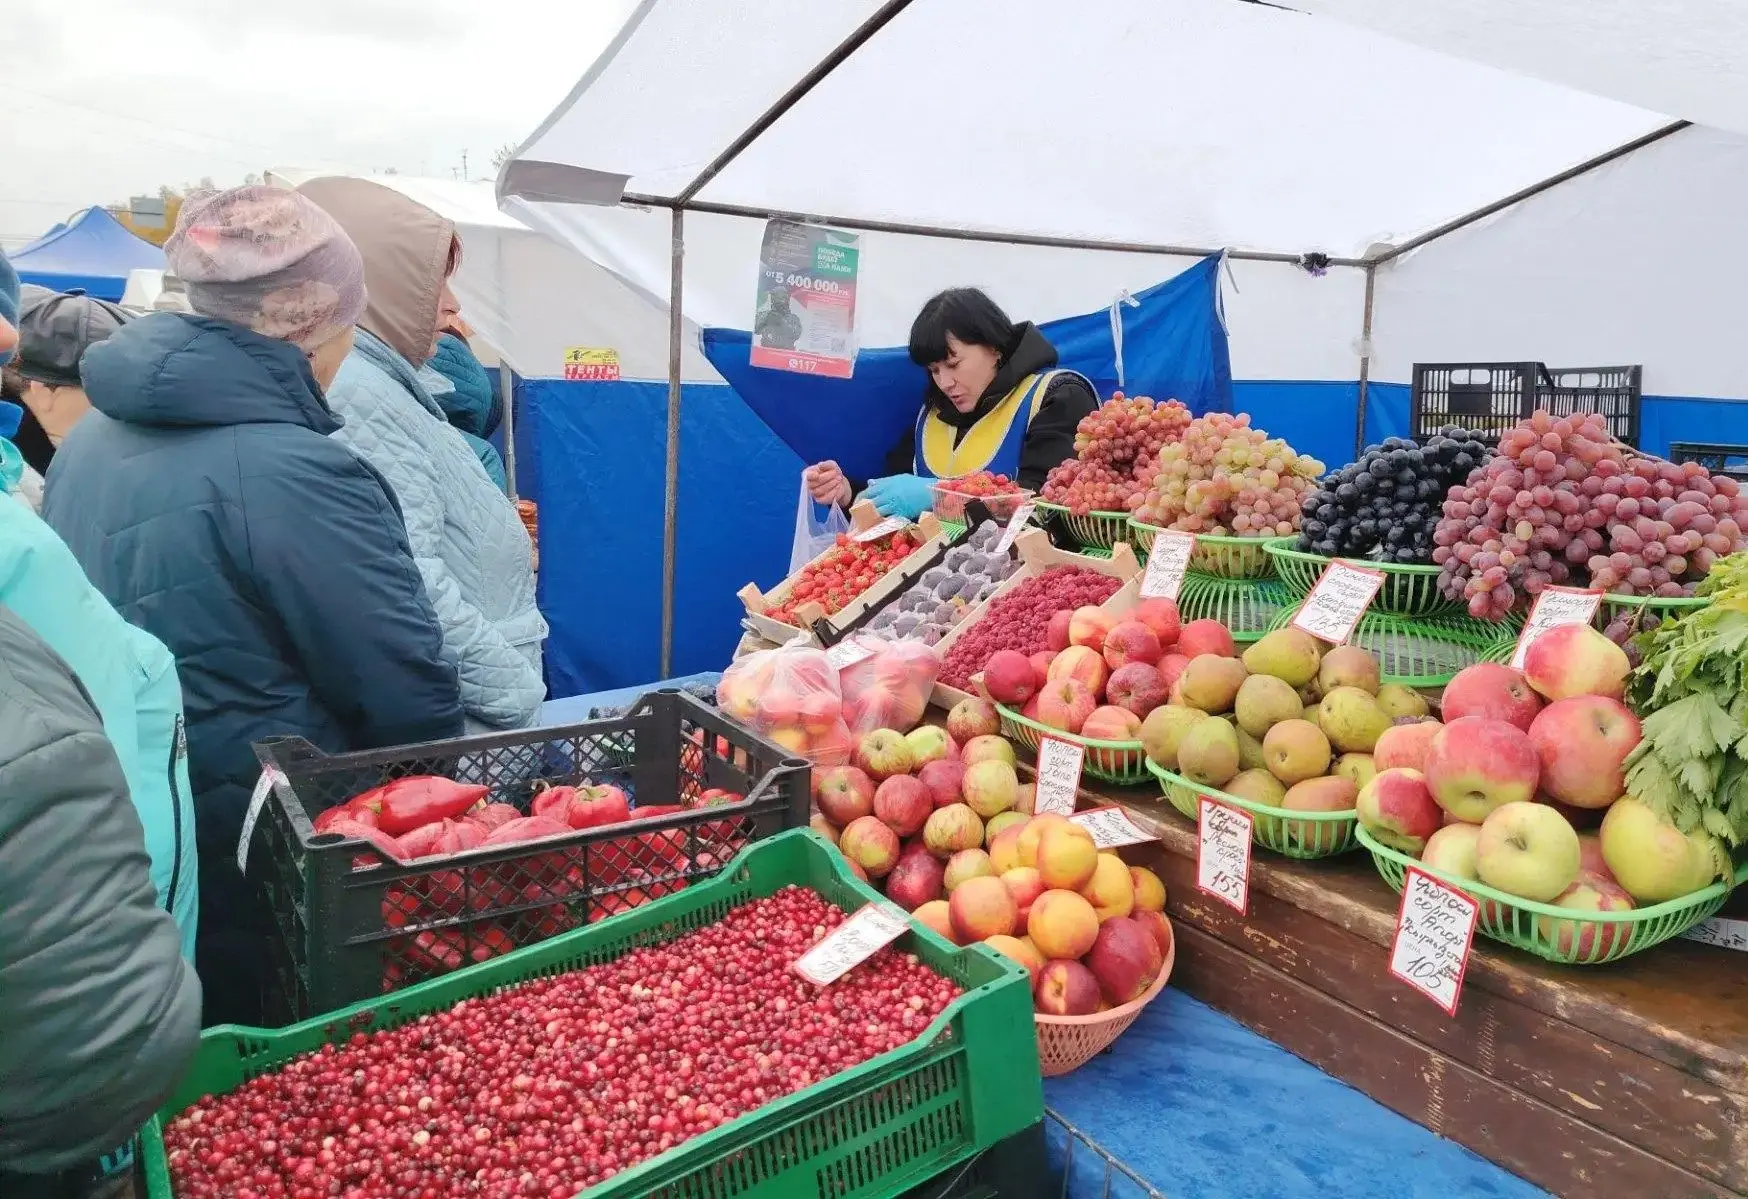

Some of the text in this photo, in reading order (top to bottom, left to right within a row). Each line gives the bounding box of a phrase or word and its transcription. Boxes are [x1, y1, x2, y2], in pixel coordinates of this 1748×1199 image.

[787, 273, 812, 289] 400
[813, 278, 839, 294] 000
[567, 365, 618, 374] ТЕНТЫ
[797, 360, 817, 371] 117
[1211, 870, 1244, 899] 155
[1414, 897, 1455, 923] сорт
[1407, 955, 1443, 989] 105
